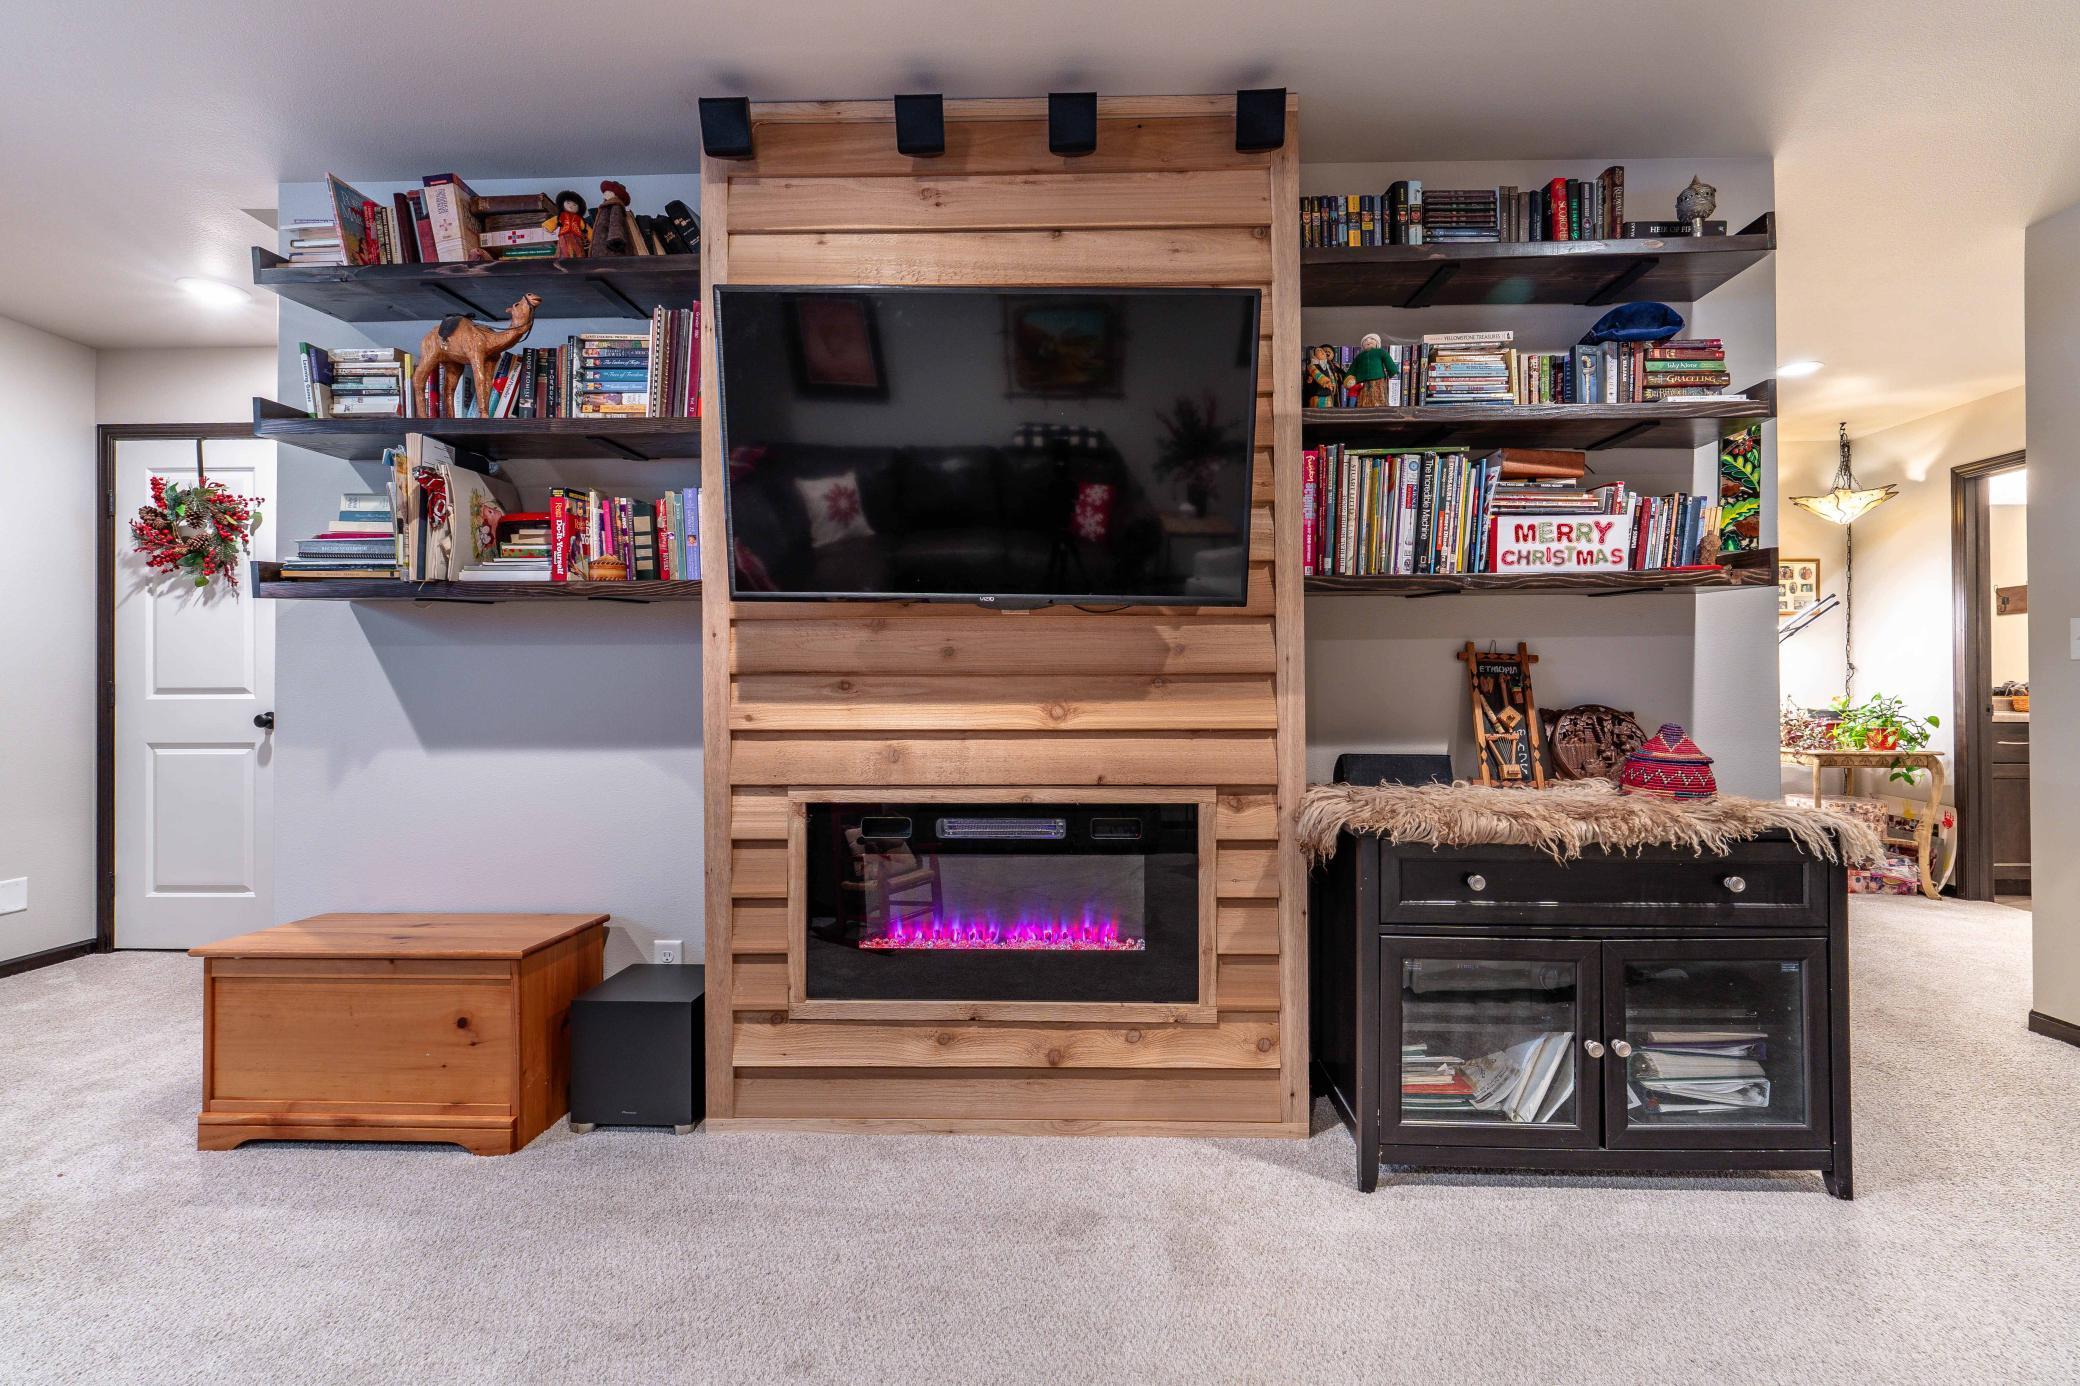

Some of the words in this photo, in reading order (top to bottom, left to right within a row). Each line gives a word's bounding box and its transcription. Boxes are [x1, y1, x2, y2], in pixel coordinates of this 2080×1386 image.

[1666, 375, 1716, 383] GRACELING
[1425, 459, 1434, 473] The
[1422, 474, 1432, 508] Incredible
[1445, 463, 1454, 501] DINOSAURS
[1420, 509, 1430, 540] Machine
[1514, 520, 1615, 545] MERRY
[1501, 545, 1625, 566] CHRISTMAS
